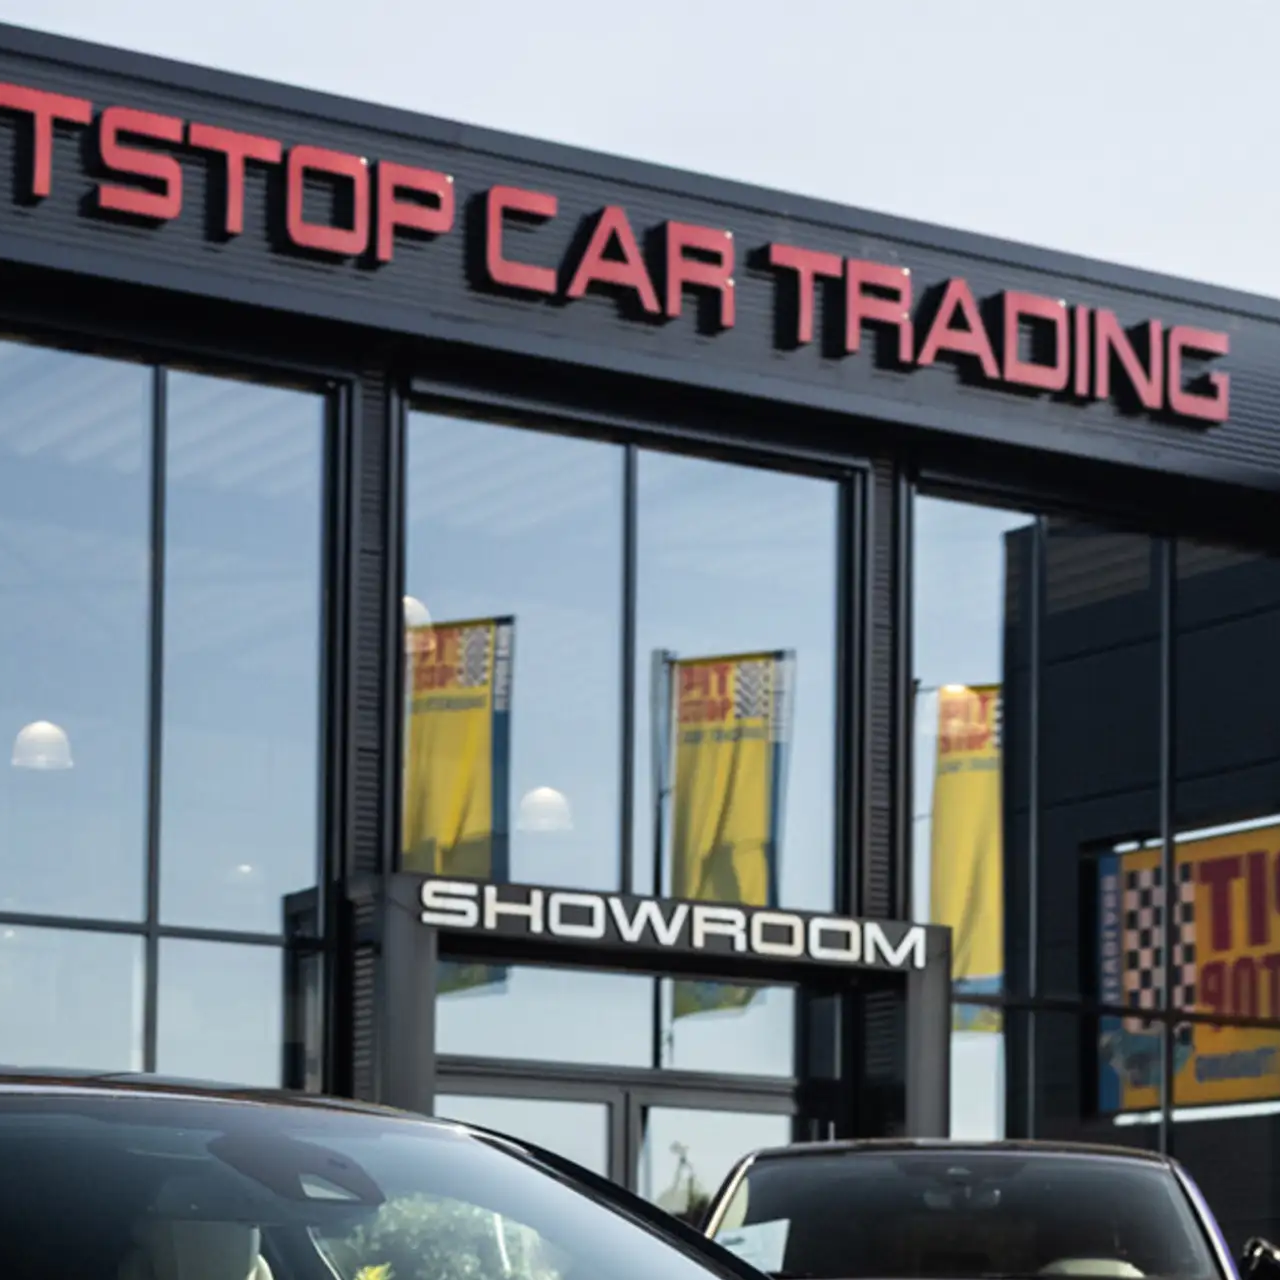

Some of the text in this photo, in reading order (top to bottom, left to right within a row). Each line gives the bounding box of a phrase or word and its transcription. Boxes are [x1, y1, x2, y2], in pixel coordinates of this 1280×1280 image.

[487, 185, 736, 327] CAR
[769, 243, 1229, 422] TRADING
[420, 879, 927, 970] SHOWROOM
